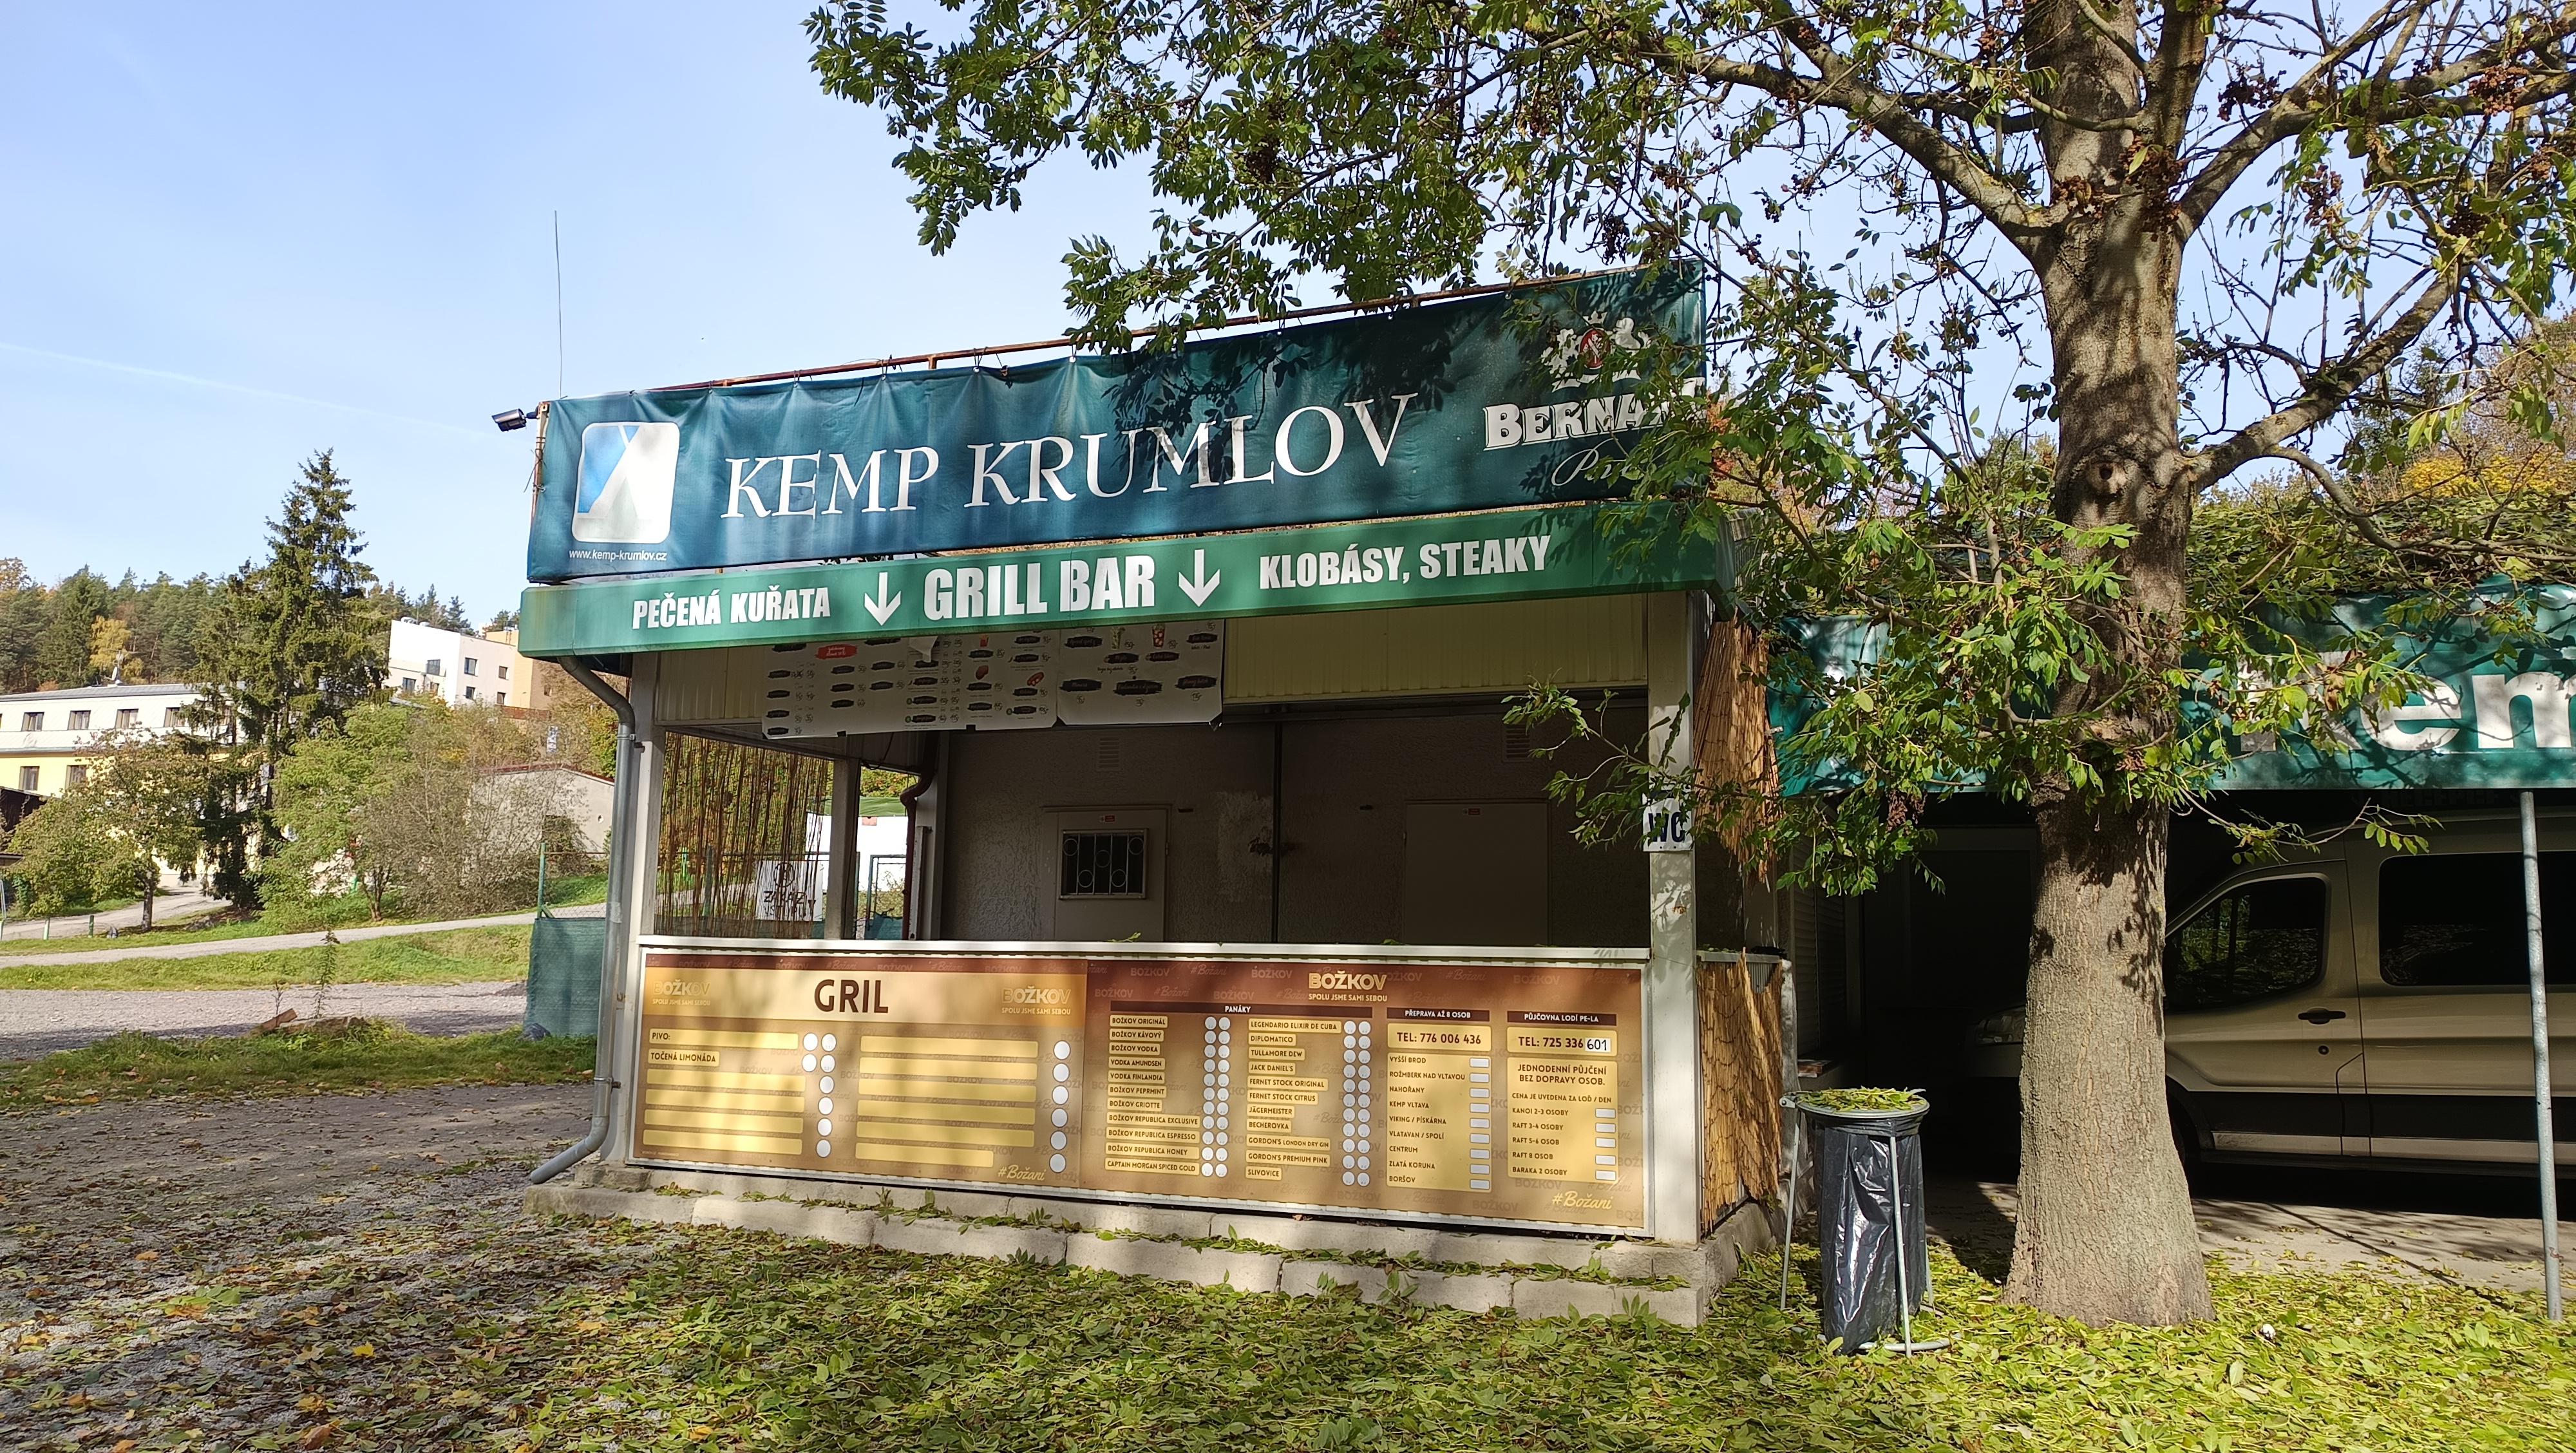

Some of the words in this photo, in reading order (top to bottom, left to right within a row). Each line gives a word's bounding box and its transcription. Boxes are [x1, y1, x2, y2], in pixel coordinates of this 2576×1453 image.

[1483, 377, 1705, 451] BERNA
[721, 446, 938, 520] KEMP
[965, 392, 1417, 508] KRUMLOV
[569, 549, 667, 562] www.kemp-krumlov.cz
[1260, 544, 1410, 589] KLOBÁSY,
[1420, 534, 1550, 578] STEAKY
[923, 563, 1047, 621] GRILL
[1060, 555, 1154, 613] BAR
[632, 589, 721, 629] PEČENÁ
[730, 585, 831, 624] KUŘATA
[1648, 812, 1685, 842] WC
[653, 980, 710, 996] BOŽKOV
[1309, 971, 1387, 990] BOŽKOV
[815, 979, 888, 1013] GRIL
[1002, 985, 1072, 1004] BOŽKOV
[1524, 1012, 1560, 1021] PŮJČOVNA
[1397, 1032, 1417, 1042] TEL:
[1420, 1033, 1437, 1043] 776
[1441, 1034, 1460, 1043] 006
[1463, 1034, 1481, 1044] 436
[1519, 1037, 1540, 1047] TEL:
[1543, 1038, 1562, 1047] 725
[1566, 1038, 1583, 1048] 336
[1587, 1040, 1607, 1050] 601
[651, 1051, 677, 1061] TOČENÁ
[679, 1052, 716, 1062] LIMONÁDA
[1518, 1064, 1570, 1073] JEDNODENNÍ
[1573, 1065, 1607, 1075] PŮJČENÍ
[998, 1164, 1046, 1182] #Božani
[1552, 1190, 1613, 1210] #Božani
